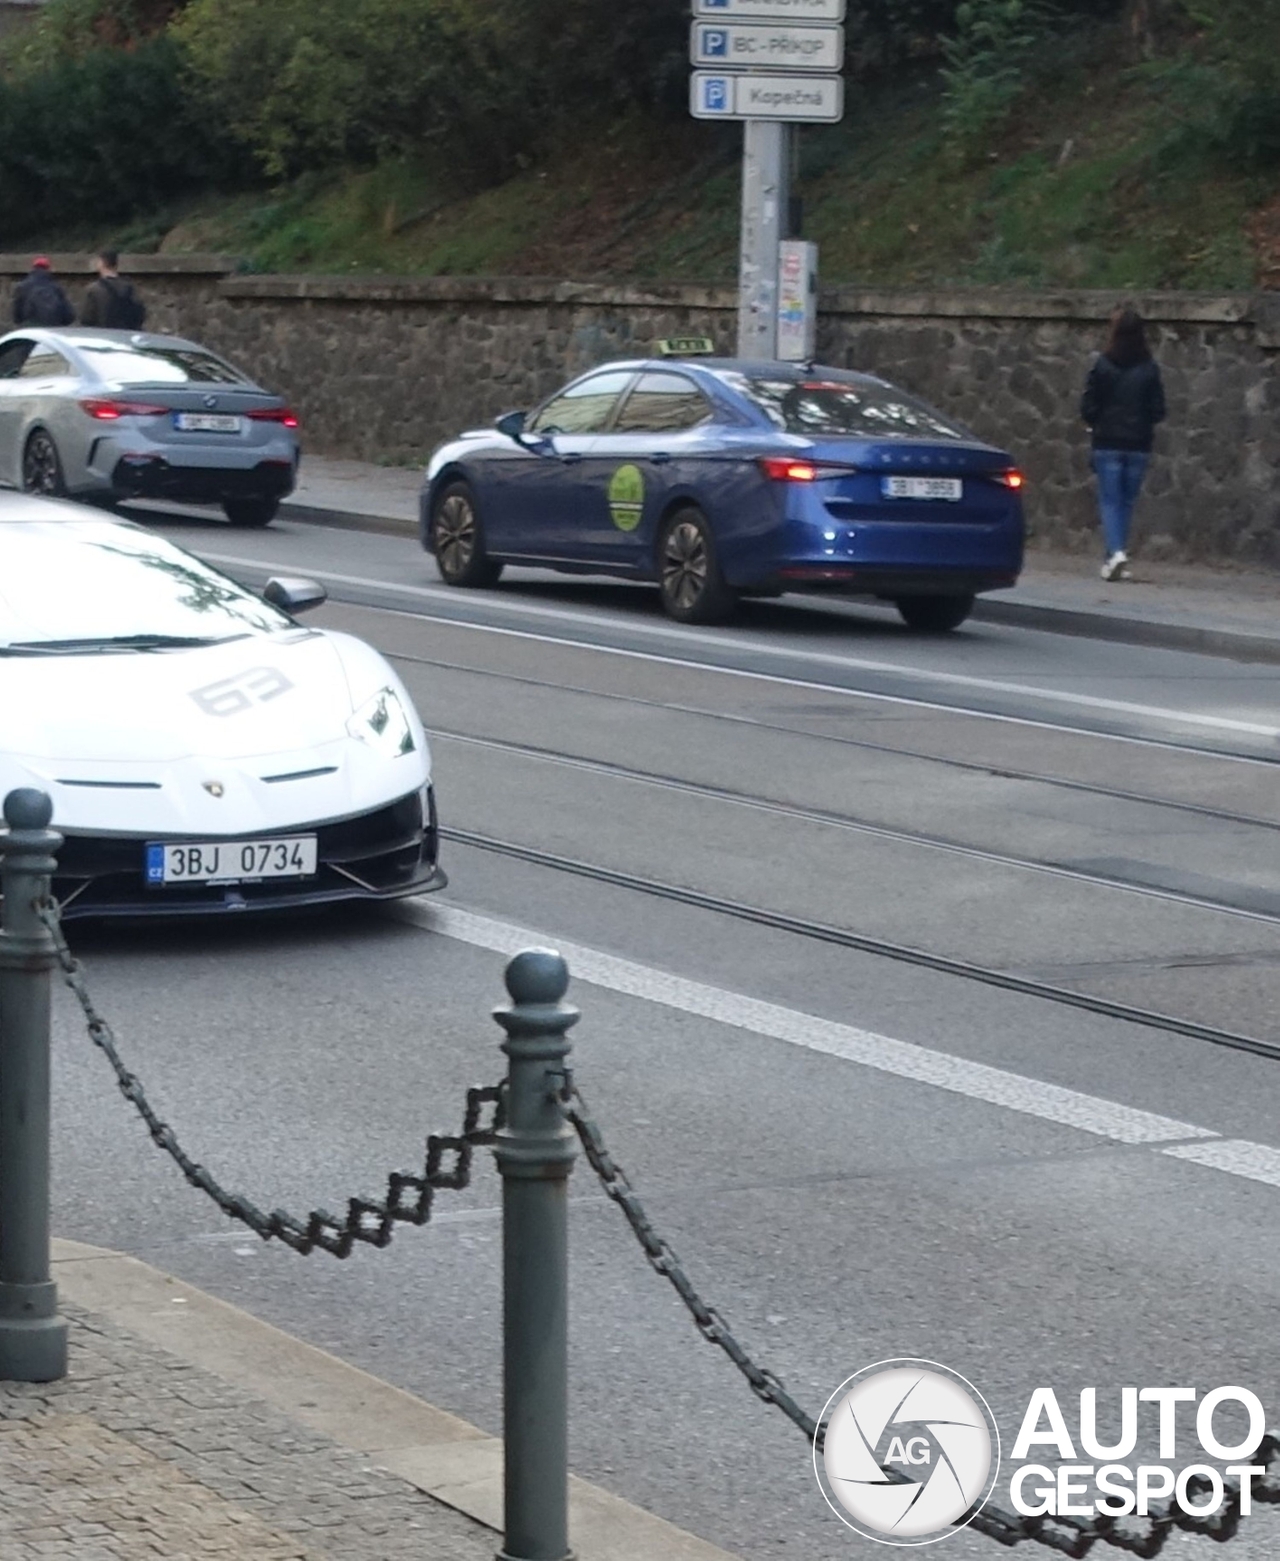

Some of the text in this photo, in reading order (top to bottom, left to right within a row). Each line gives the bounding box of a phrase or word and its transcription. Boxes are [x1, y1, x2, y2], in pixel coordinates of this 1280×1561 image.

[750, 88, 823, 107] Kopečná
[187, 666, 296, 717] 63
[170, 847, 220, 876] 3BJ
[241, 843, 304, 873] 0734
